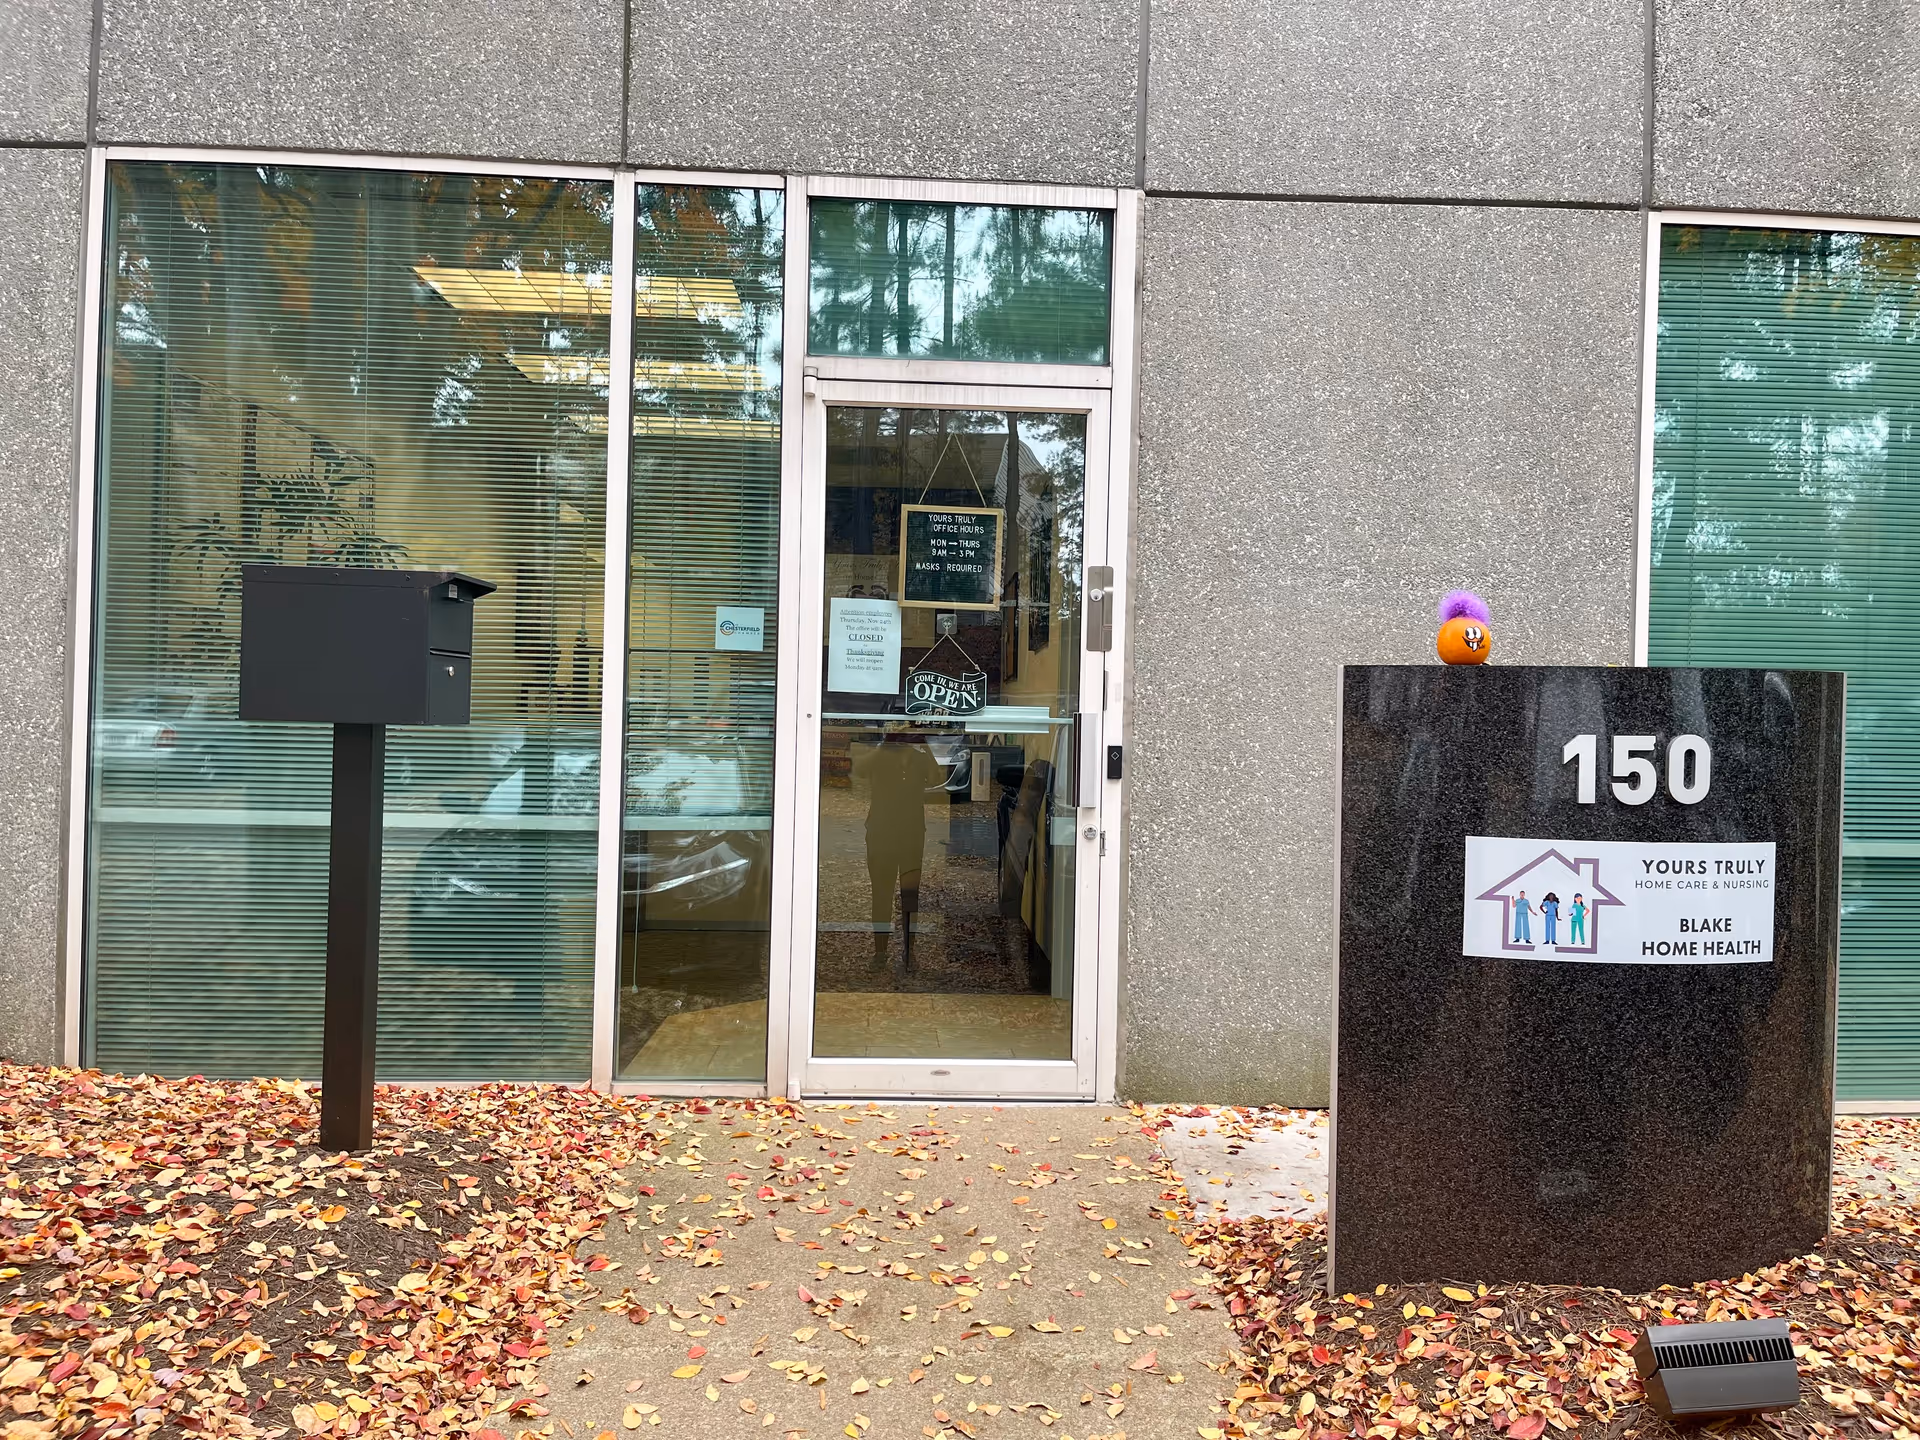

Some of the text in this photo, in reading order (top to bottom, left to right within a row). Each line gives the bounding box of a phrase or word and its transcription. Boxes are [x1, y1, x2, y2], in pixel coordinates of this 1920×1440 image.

[928, 514, 977, 524] YOURS TRULY
[933, 524, 985, 534] OFFICE HOURS
[930, 538, 981, 548] MON THURS
[915, 562, 983, 573] MASKS REQUIRED
[848, 633, 884, 641] CLOSED
[846, 648, 884, 657] Thanksgiving
[914, 674, 935, 684] COME
[948, 681, 960, 690] WE
[961, 683, 977, 691] ARE
[913, 682, 979, 709] OPEN
[1563, 734, 1711, 806] 150
[1641, 859, 1766, 875] YOURS TRULY
[1635, 879, 1769, 890] HOME CARE & NURSING
[1679, 917, 1733, 933] BLAKE
[1642, 939, 1762, 956] HOME HEALTH
